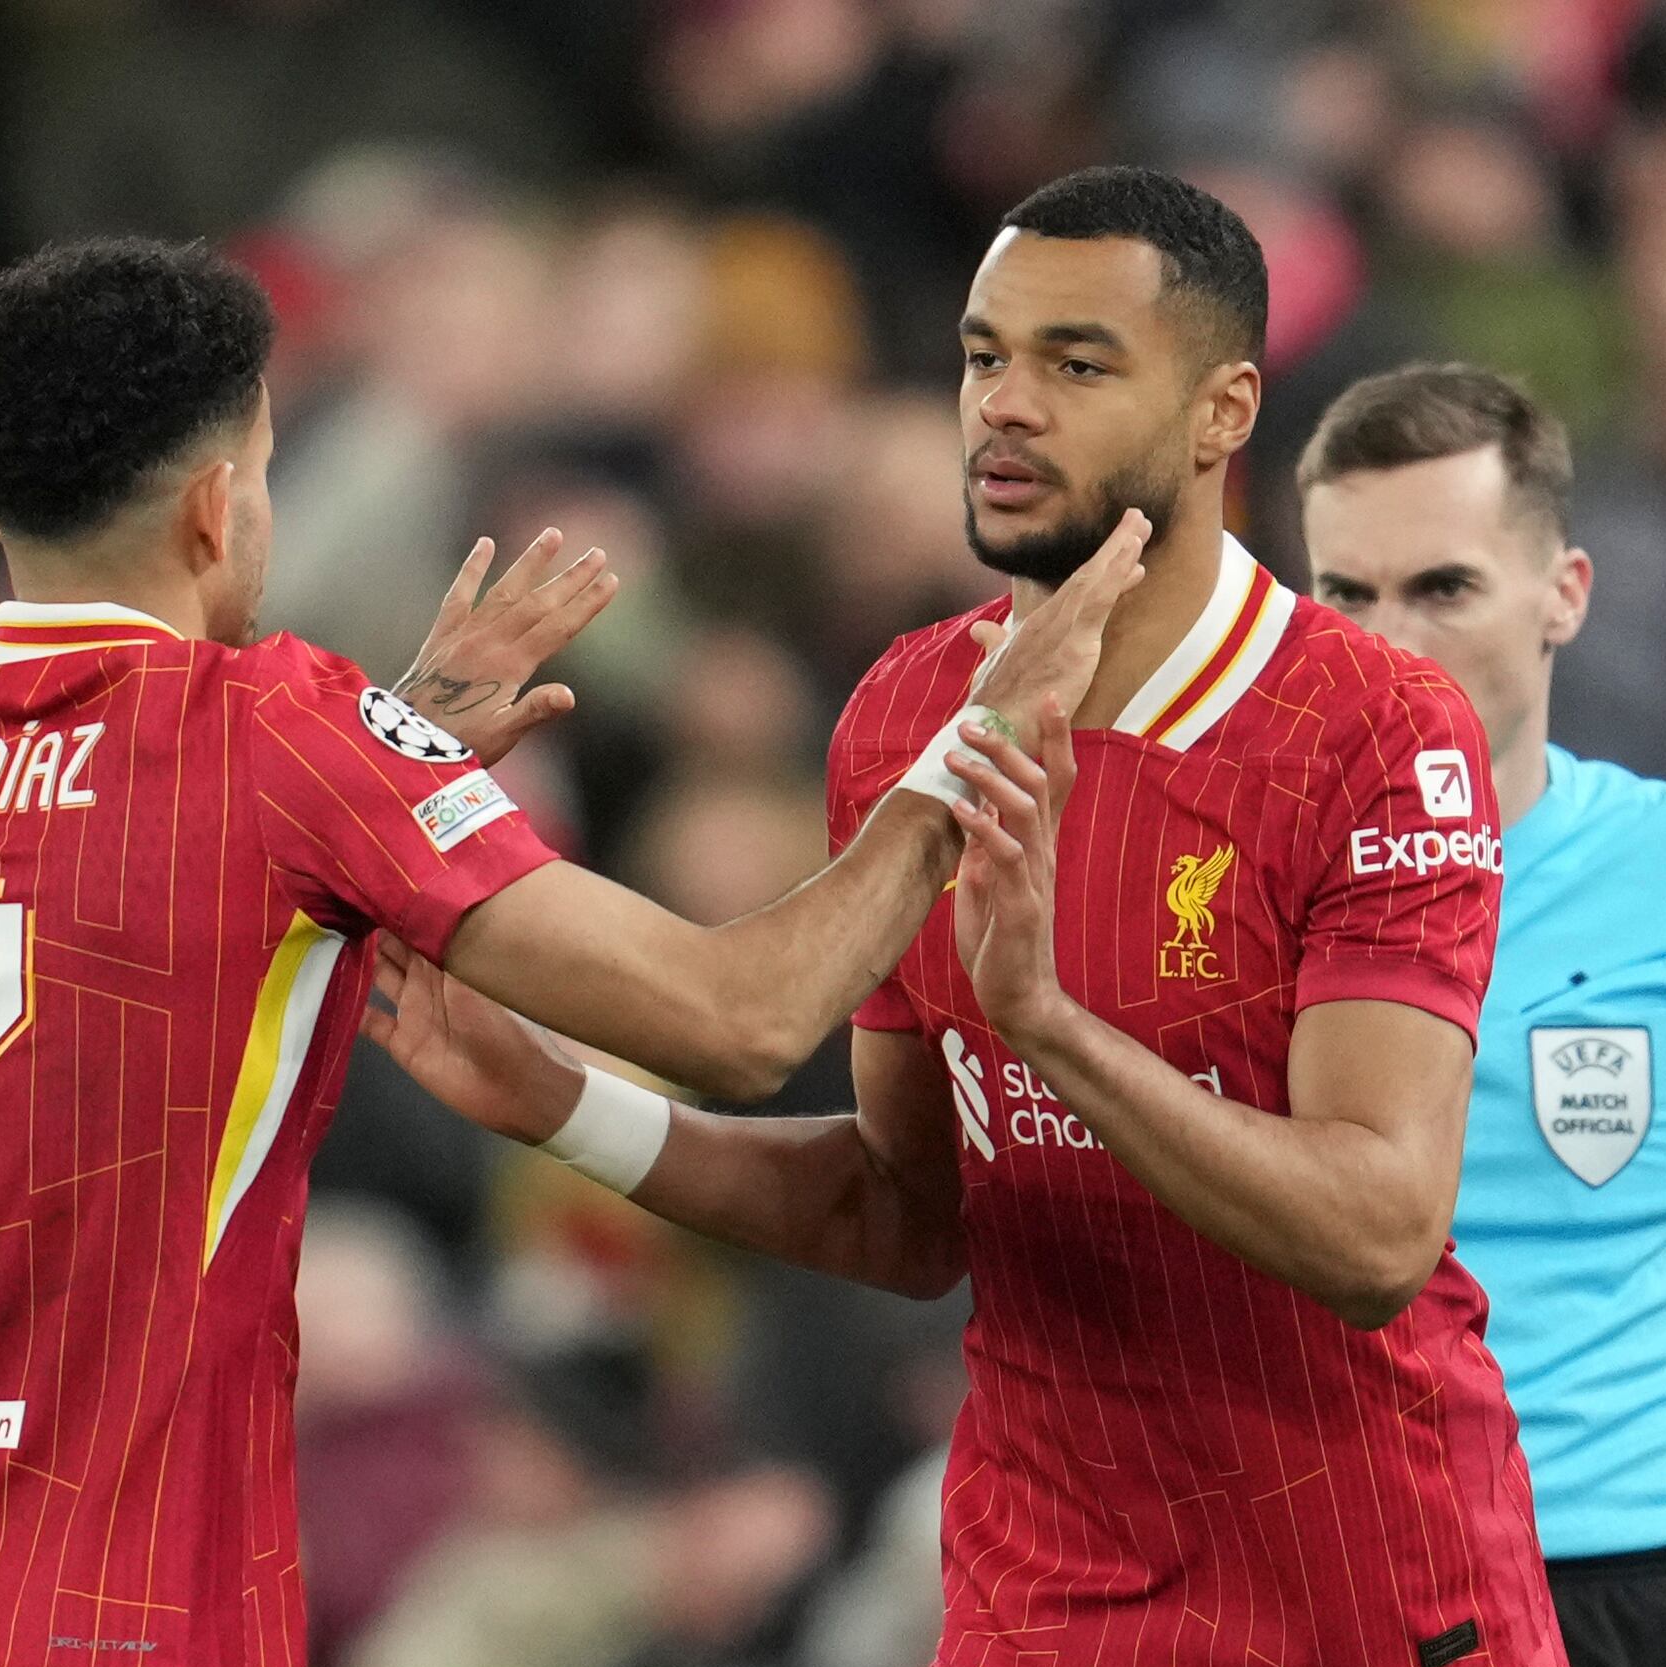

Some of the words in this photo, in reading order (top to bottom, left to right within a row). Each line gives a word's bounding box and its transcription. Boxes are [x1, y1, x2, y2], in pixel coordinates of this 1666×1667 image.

[1554, 1042, 1625, 1073] UEFA
[1560, 1093, 1628, 1110] MATCH
[1552, 1117, 1636, 1135] OFFICIAL
